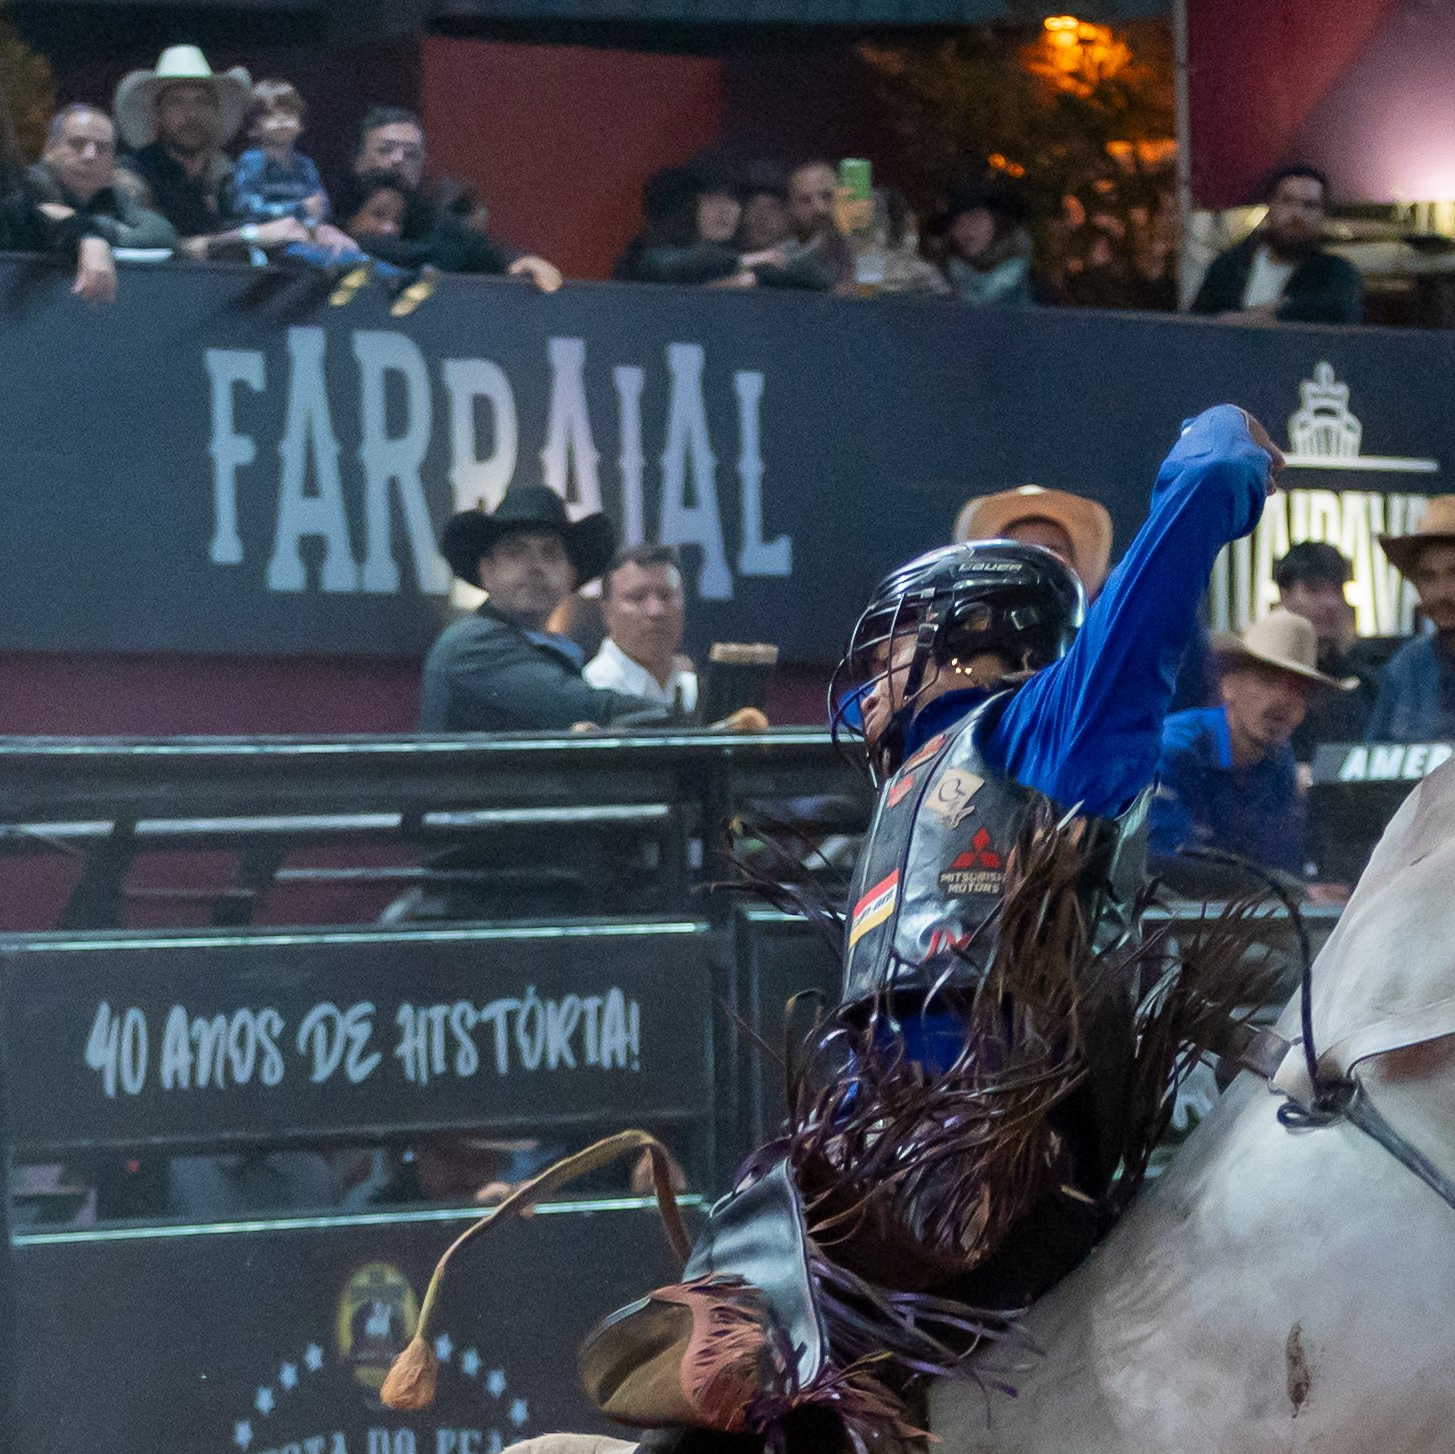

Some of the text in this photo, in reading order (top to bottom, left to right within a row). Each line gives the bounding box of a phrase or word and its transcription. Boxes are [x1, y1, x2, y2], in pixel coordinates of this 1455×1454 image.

[86, 1001, 146, 1098] 40
[160, 1004, 284, 1090] ANOS
[298, 1001, 382, 1085] DE
